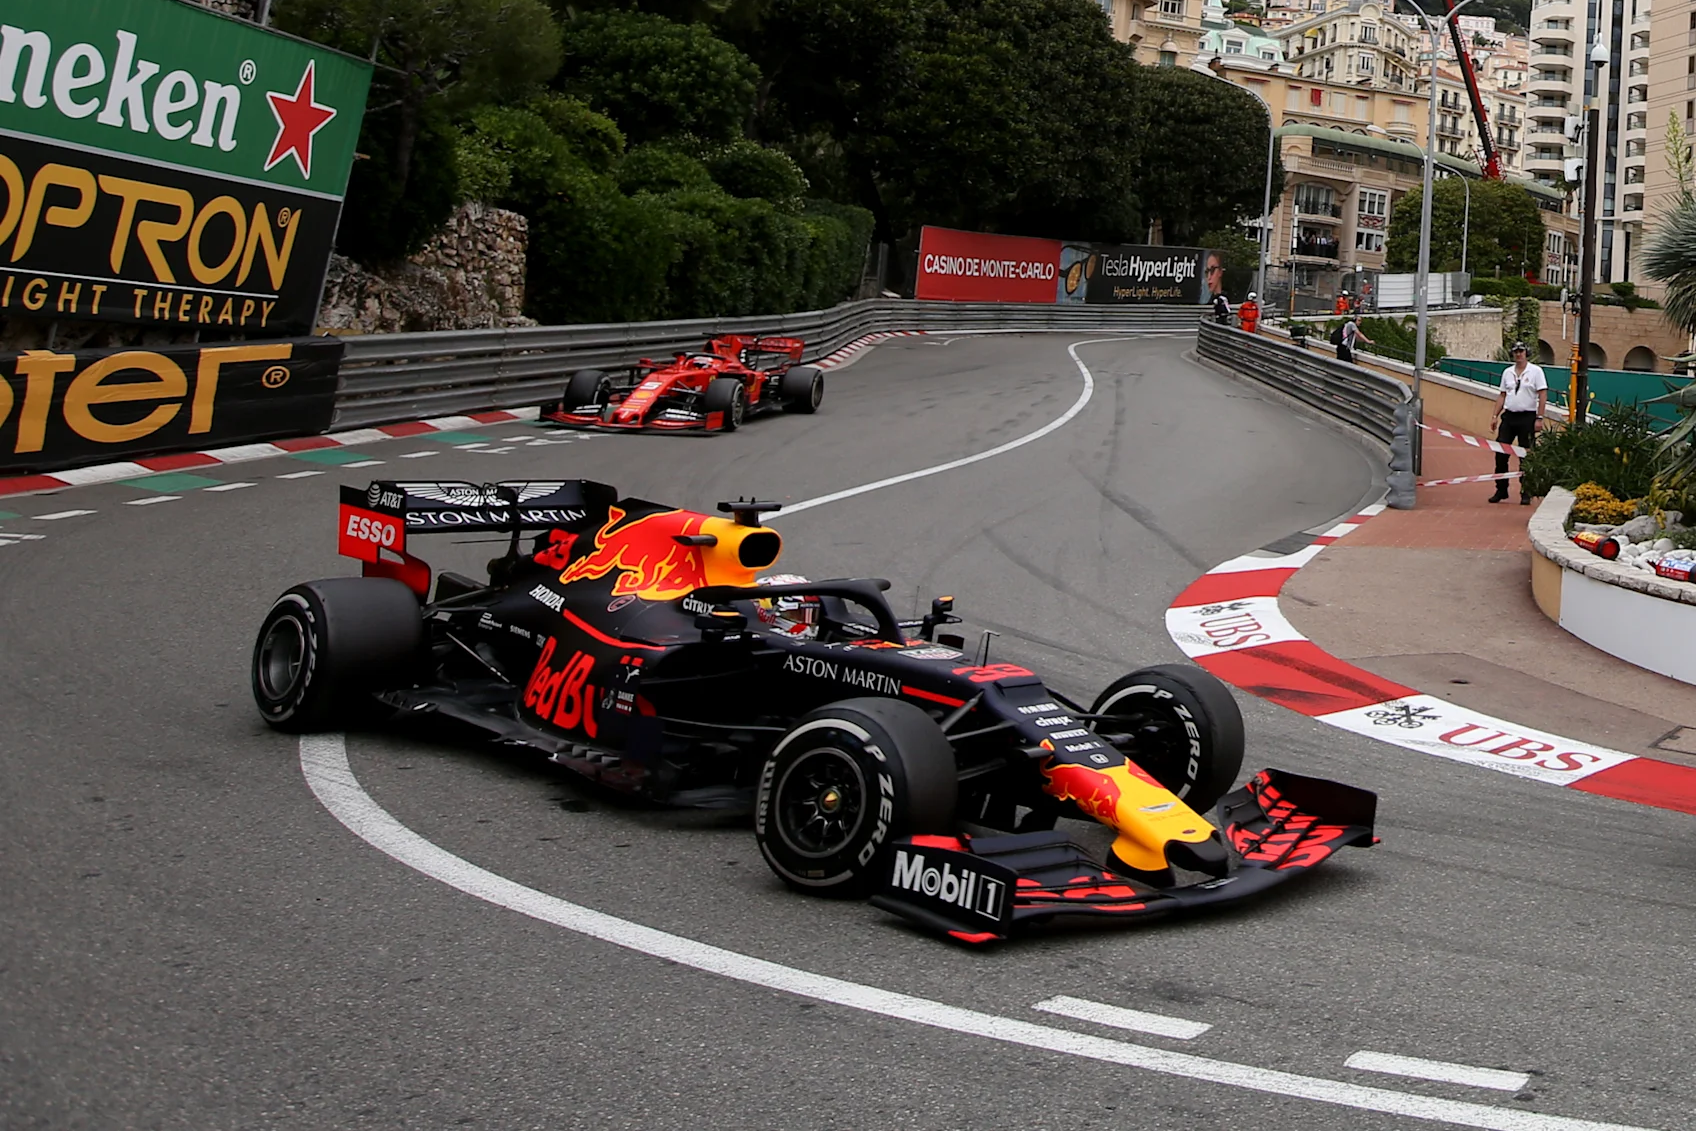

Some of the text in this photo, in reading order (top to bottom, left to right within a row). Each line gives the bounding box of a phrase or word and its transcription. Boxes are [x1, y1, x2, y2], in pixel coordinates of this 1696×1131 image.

[924, 253, 1054, 280] CASINO DE MONTE-CARLO
[133, 288, 276, 327] THERAPY
[0, 343, 293, 454] ter
[380, 492, 402, 510] AT&T
[450, 488, 479, 496] ASTON
[346, 514, 396, 547] ESSO
[406, 510, 486, 525] STON
[529, 584, 565, 612] HONDA
[1200, 613, 1271, 647] UBS
[783, 654, 901, 695] ASTON MARTIN
[1153, 689, 1200, 781] P ZERO
[1438, 722, 1602, 771] UBS
[756, 759, 776, 835] PIRELLI
[858, 744, 895, 867] P ZERO
[892, 850, 976, 910] Mobil
